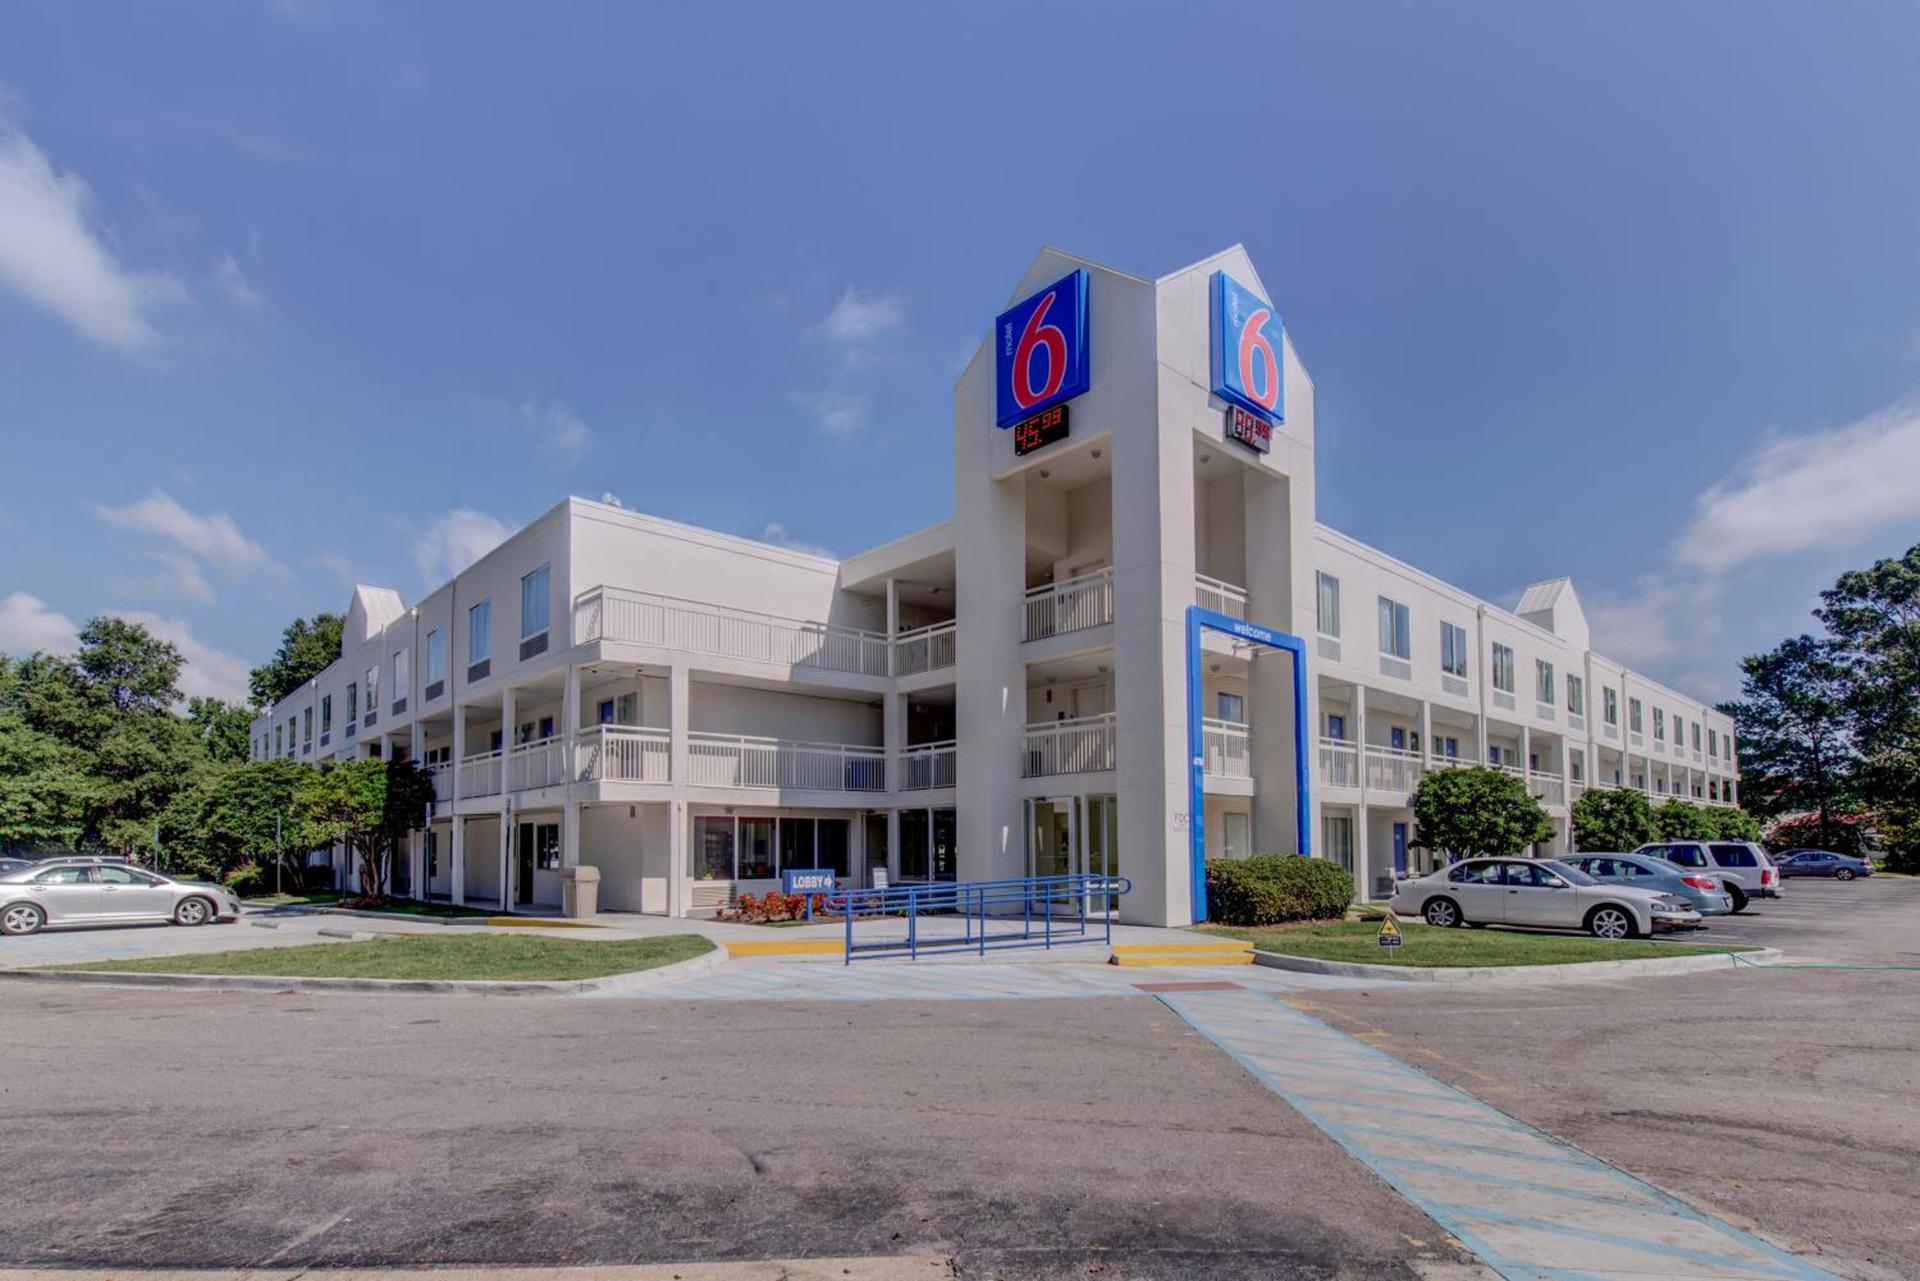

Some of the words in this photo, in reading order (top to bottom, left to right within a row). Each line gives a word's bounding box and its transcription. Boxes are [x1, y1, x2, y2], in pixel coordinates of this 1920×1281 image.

[1012, 291, 1067, 409] 6
[1239, 308, 1278, 411] 6
[1233, 622, 1272, 642] welcome
[792, 876, 823, 889] LOBBY
